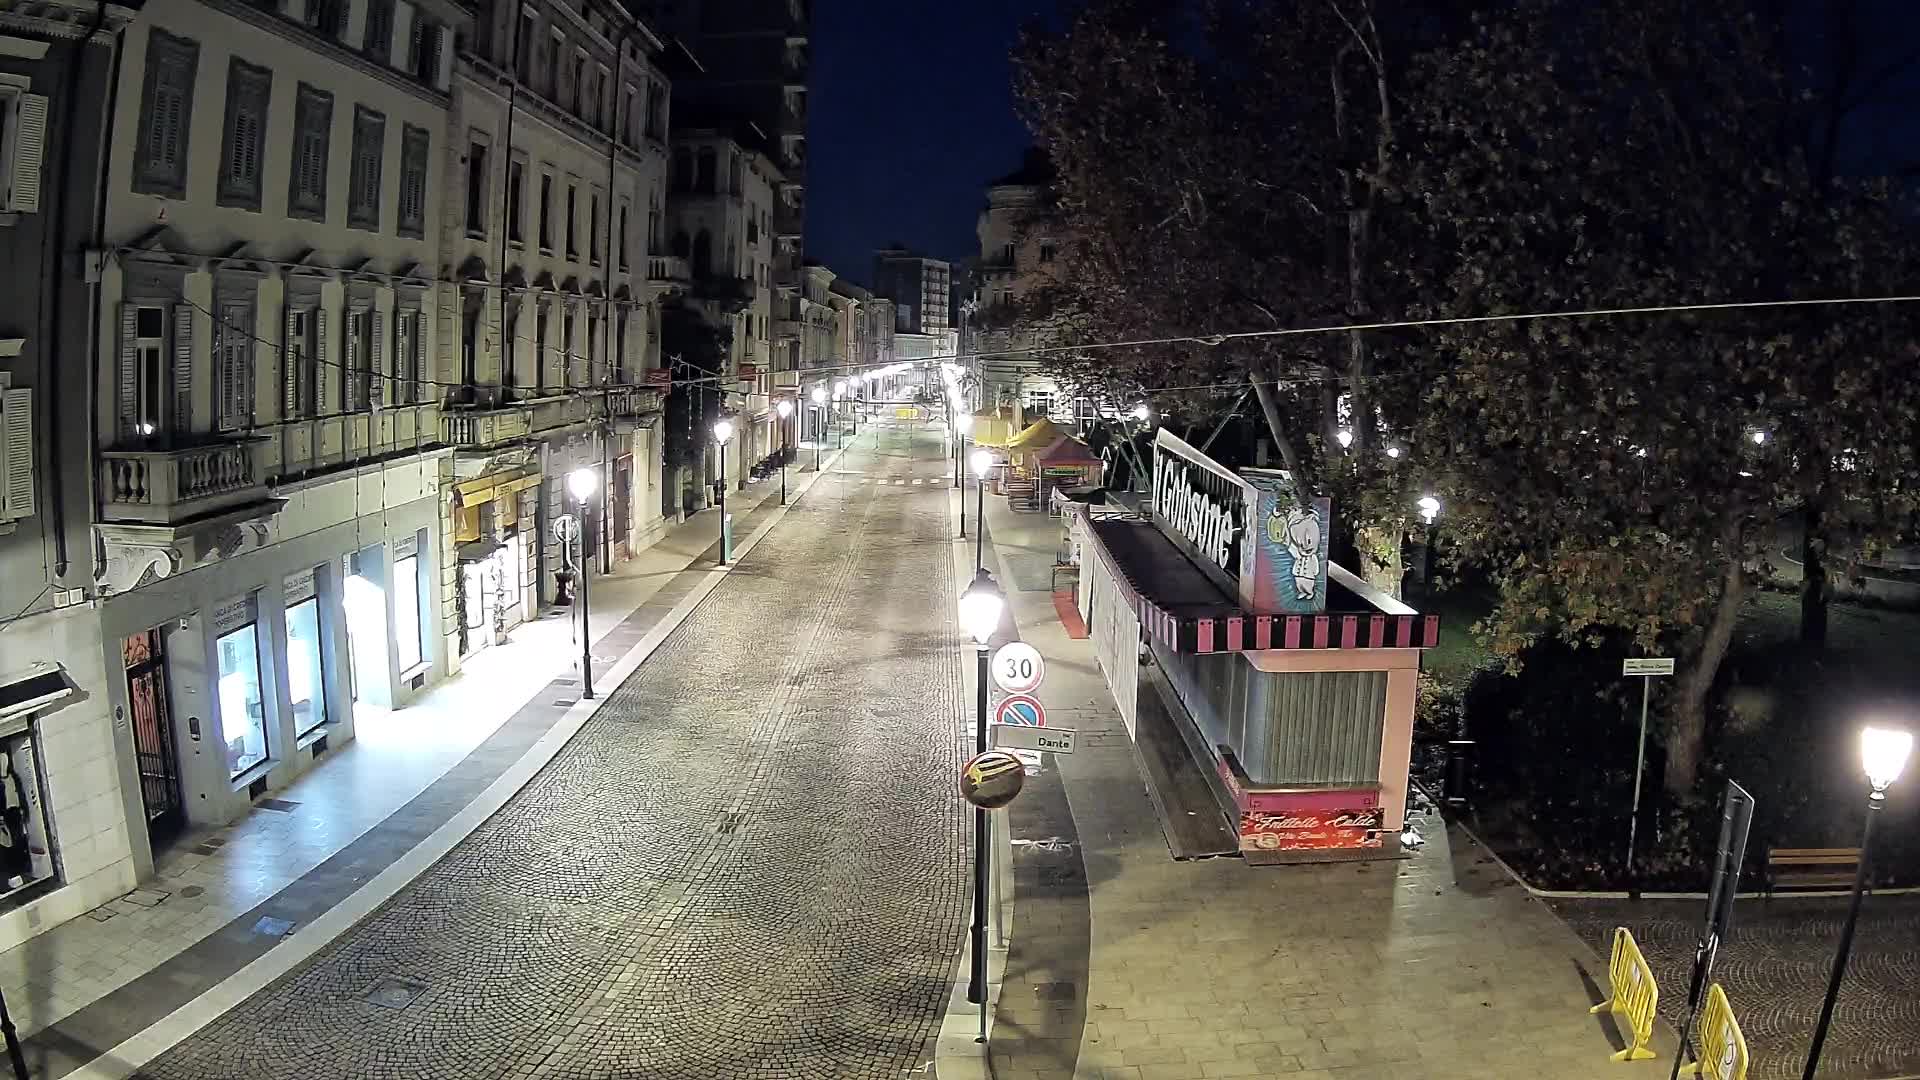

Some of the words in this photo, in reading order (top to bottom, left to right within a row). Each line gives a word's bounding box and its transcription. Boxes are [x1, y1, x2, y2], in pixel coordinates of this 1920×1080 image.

[1162, 458, 1233, 569] Golosone
[1006, 658, 1032, 678] 30
[1038, 737, 1070, 749] Dante
